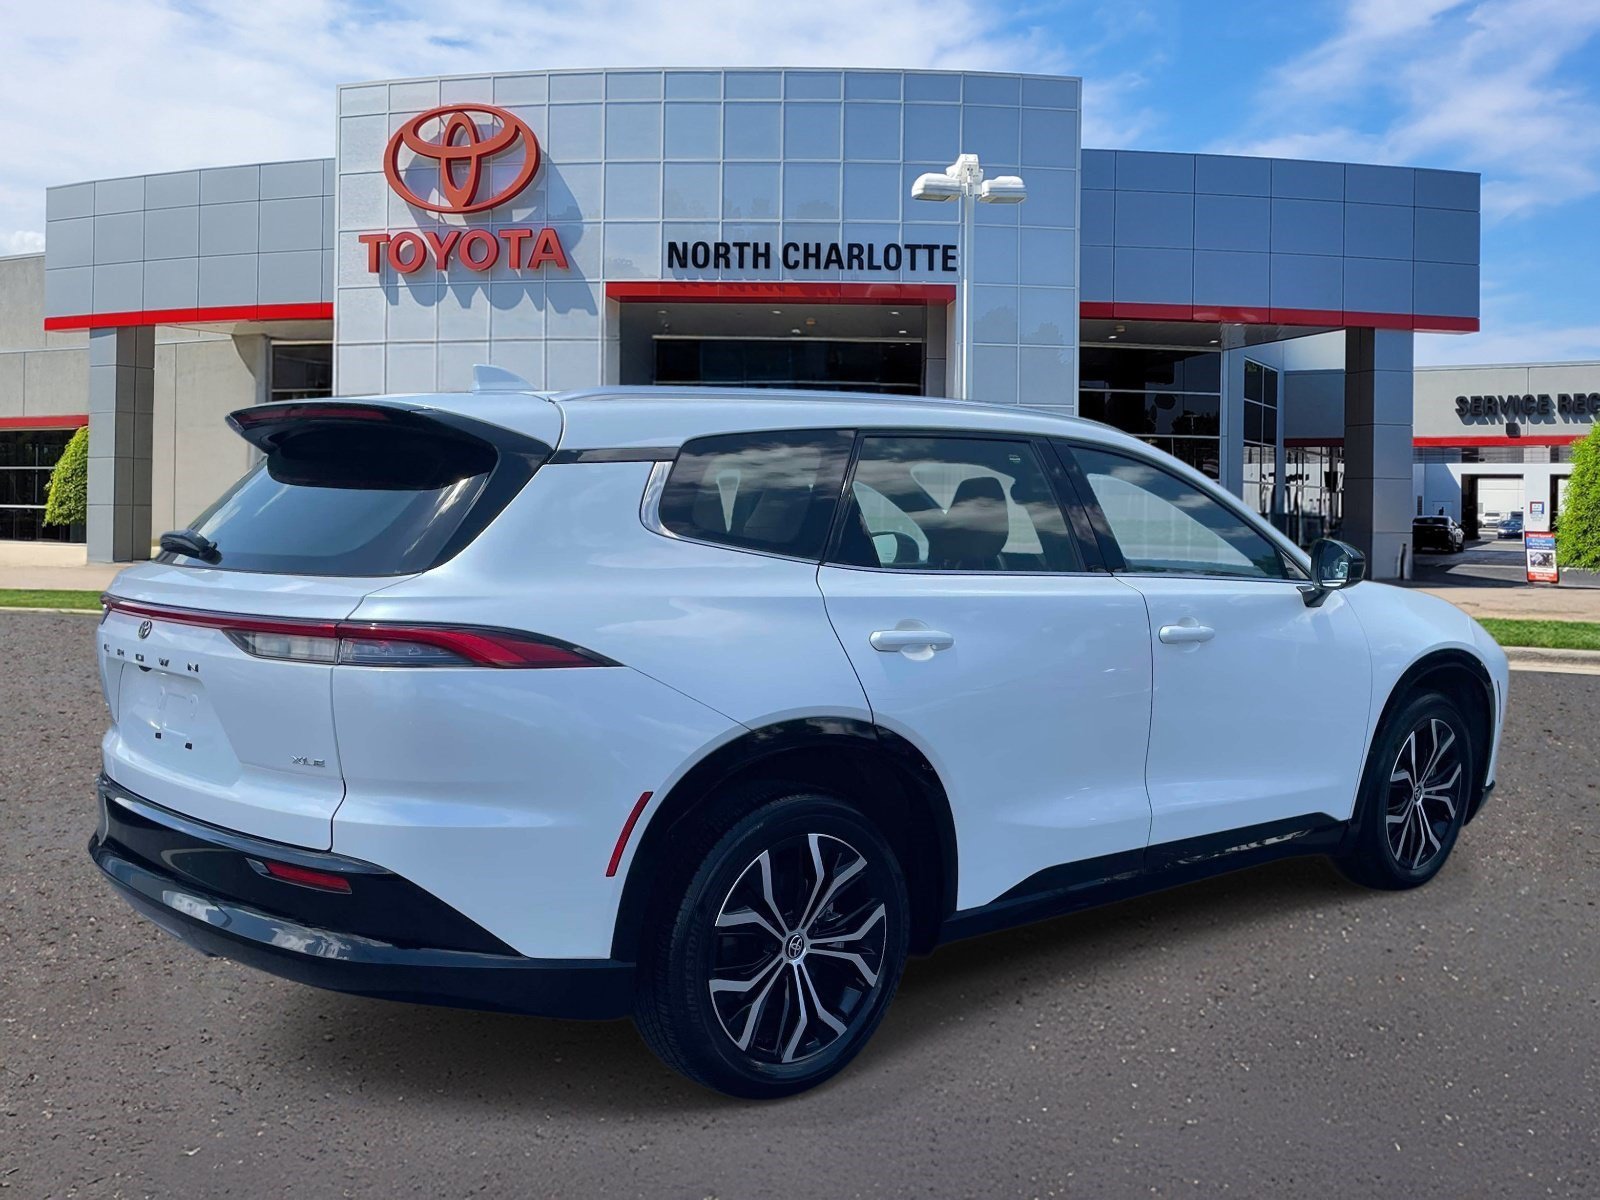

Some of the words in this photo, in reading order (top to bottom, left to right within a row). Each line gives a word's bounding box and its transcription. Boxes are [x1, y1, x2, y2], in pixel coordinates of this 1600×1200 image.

[358, 227, 569, 274] TOYOTA
[667, 241, 771, 270] NORTH
[782, 242, 958, 272] CHARLOTTE
[1455, 394, 1553, 417] SERVICE
[1557, 393, 1600, 416] REC
[103, 643, 199, 673] CROWN
